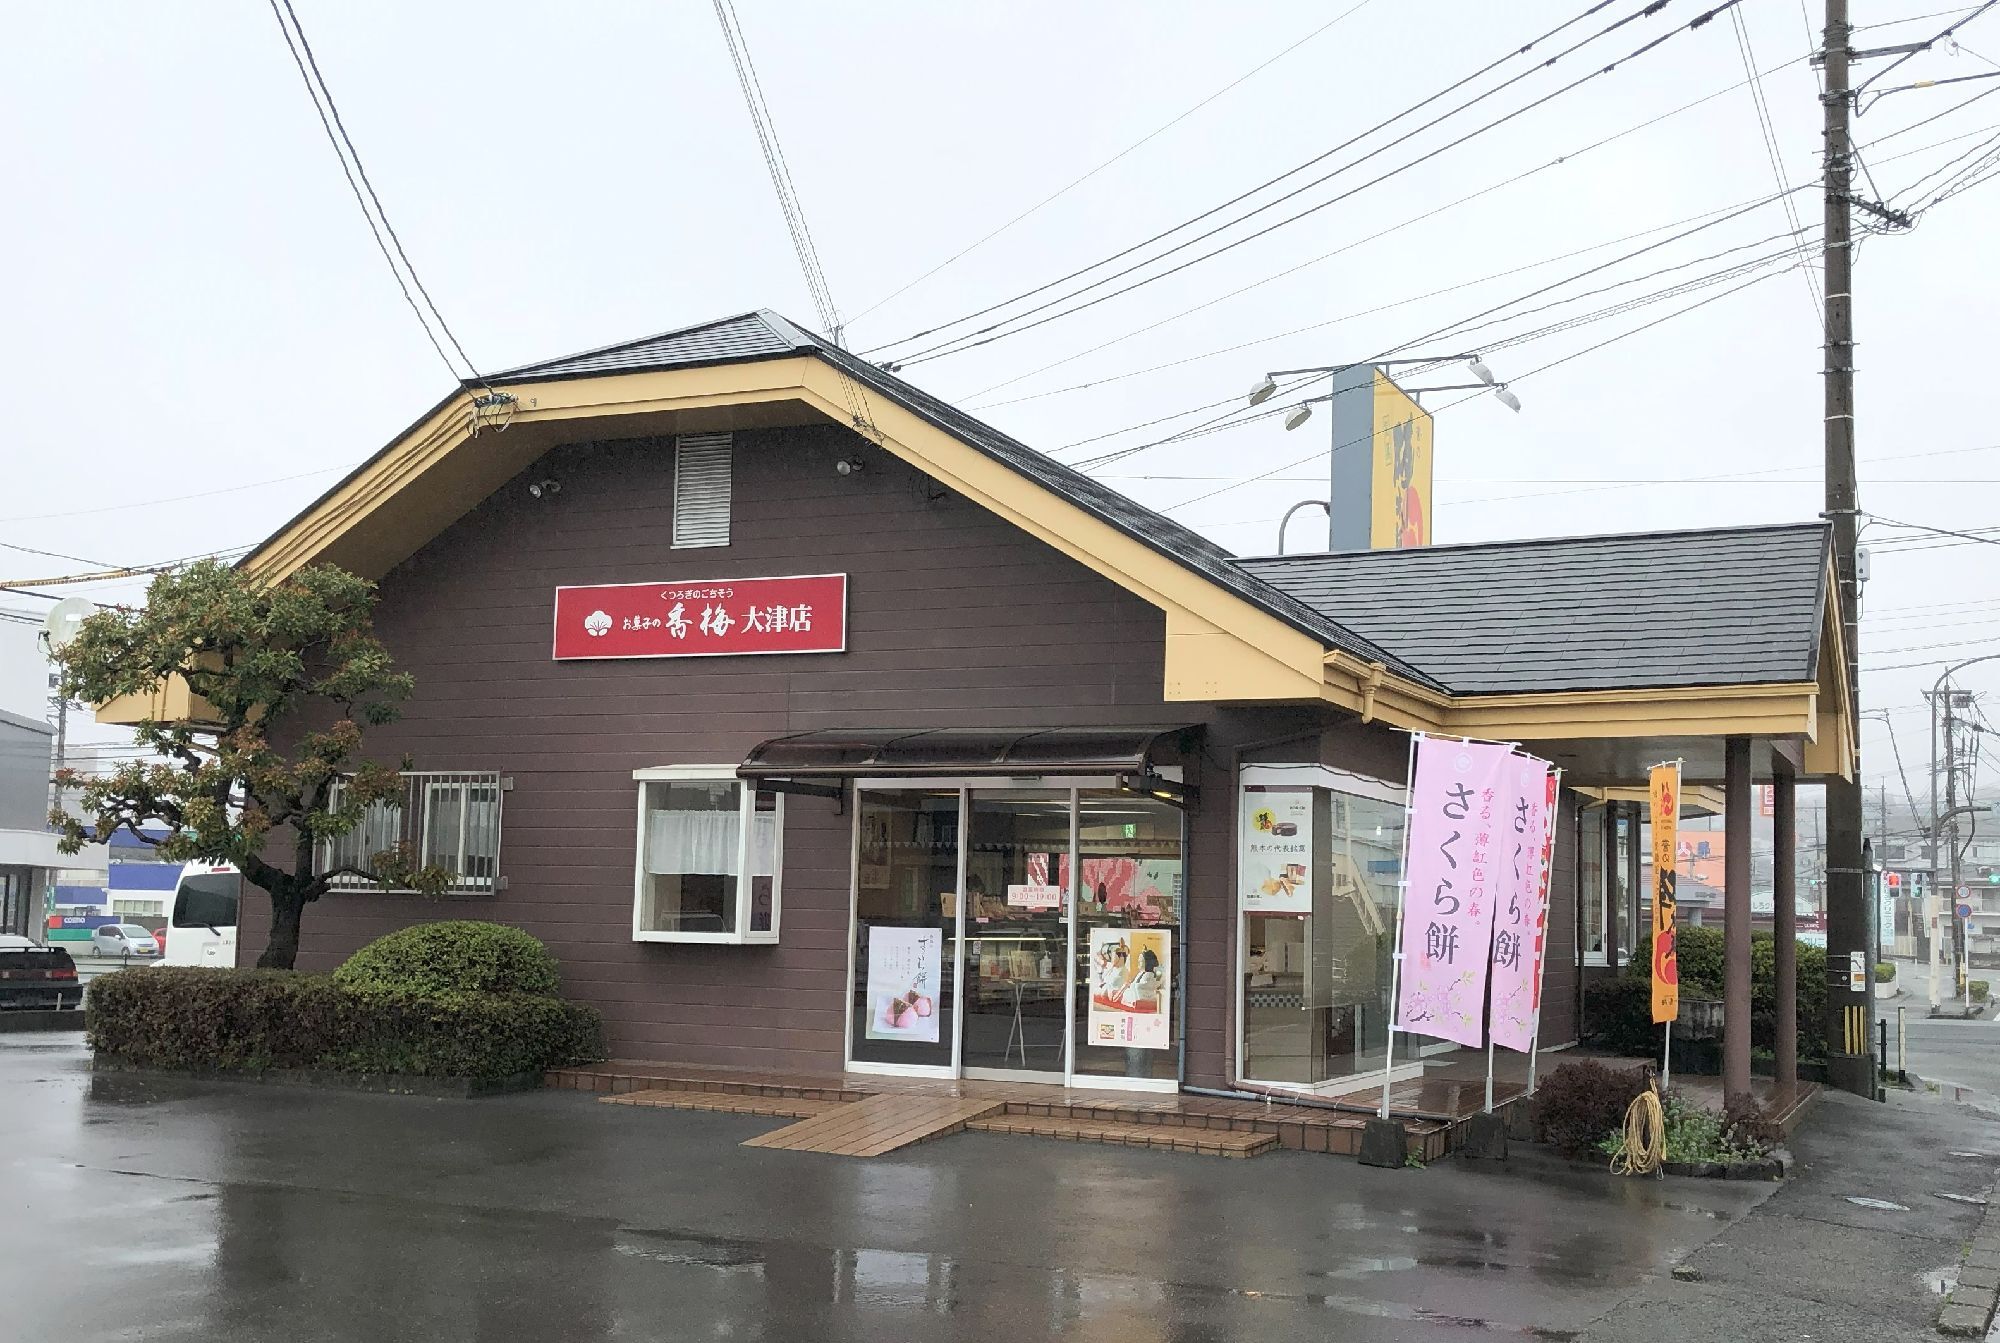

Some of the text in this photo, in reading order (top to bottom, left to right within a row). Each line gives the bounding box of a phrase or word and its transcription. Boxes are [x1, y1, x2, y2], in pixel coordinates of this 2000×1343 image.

[623, 614, 661, 631] お菓子の
[741, 603, 813, 633] 大津店
[660, 588, 734, 600] くつろぎのごちそう
[1425, 782, 1475, 965] さくら餅
[1493, 796, 1529, 973] さくら餅
